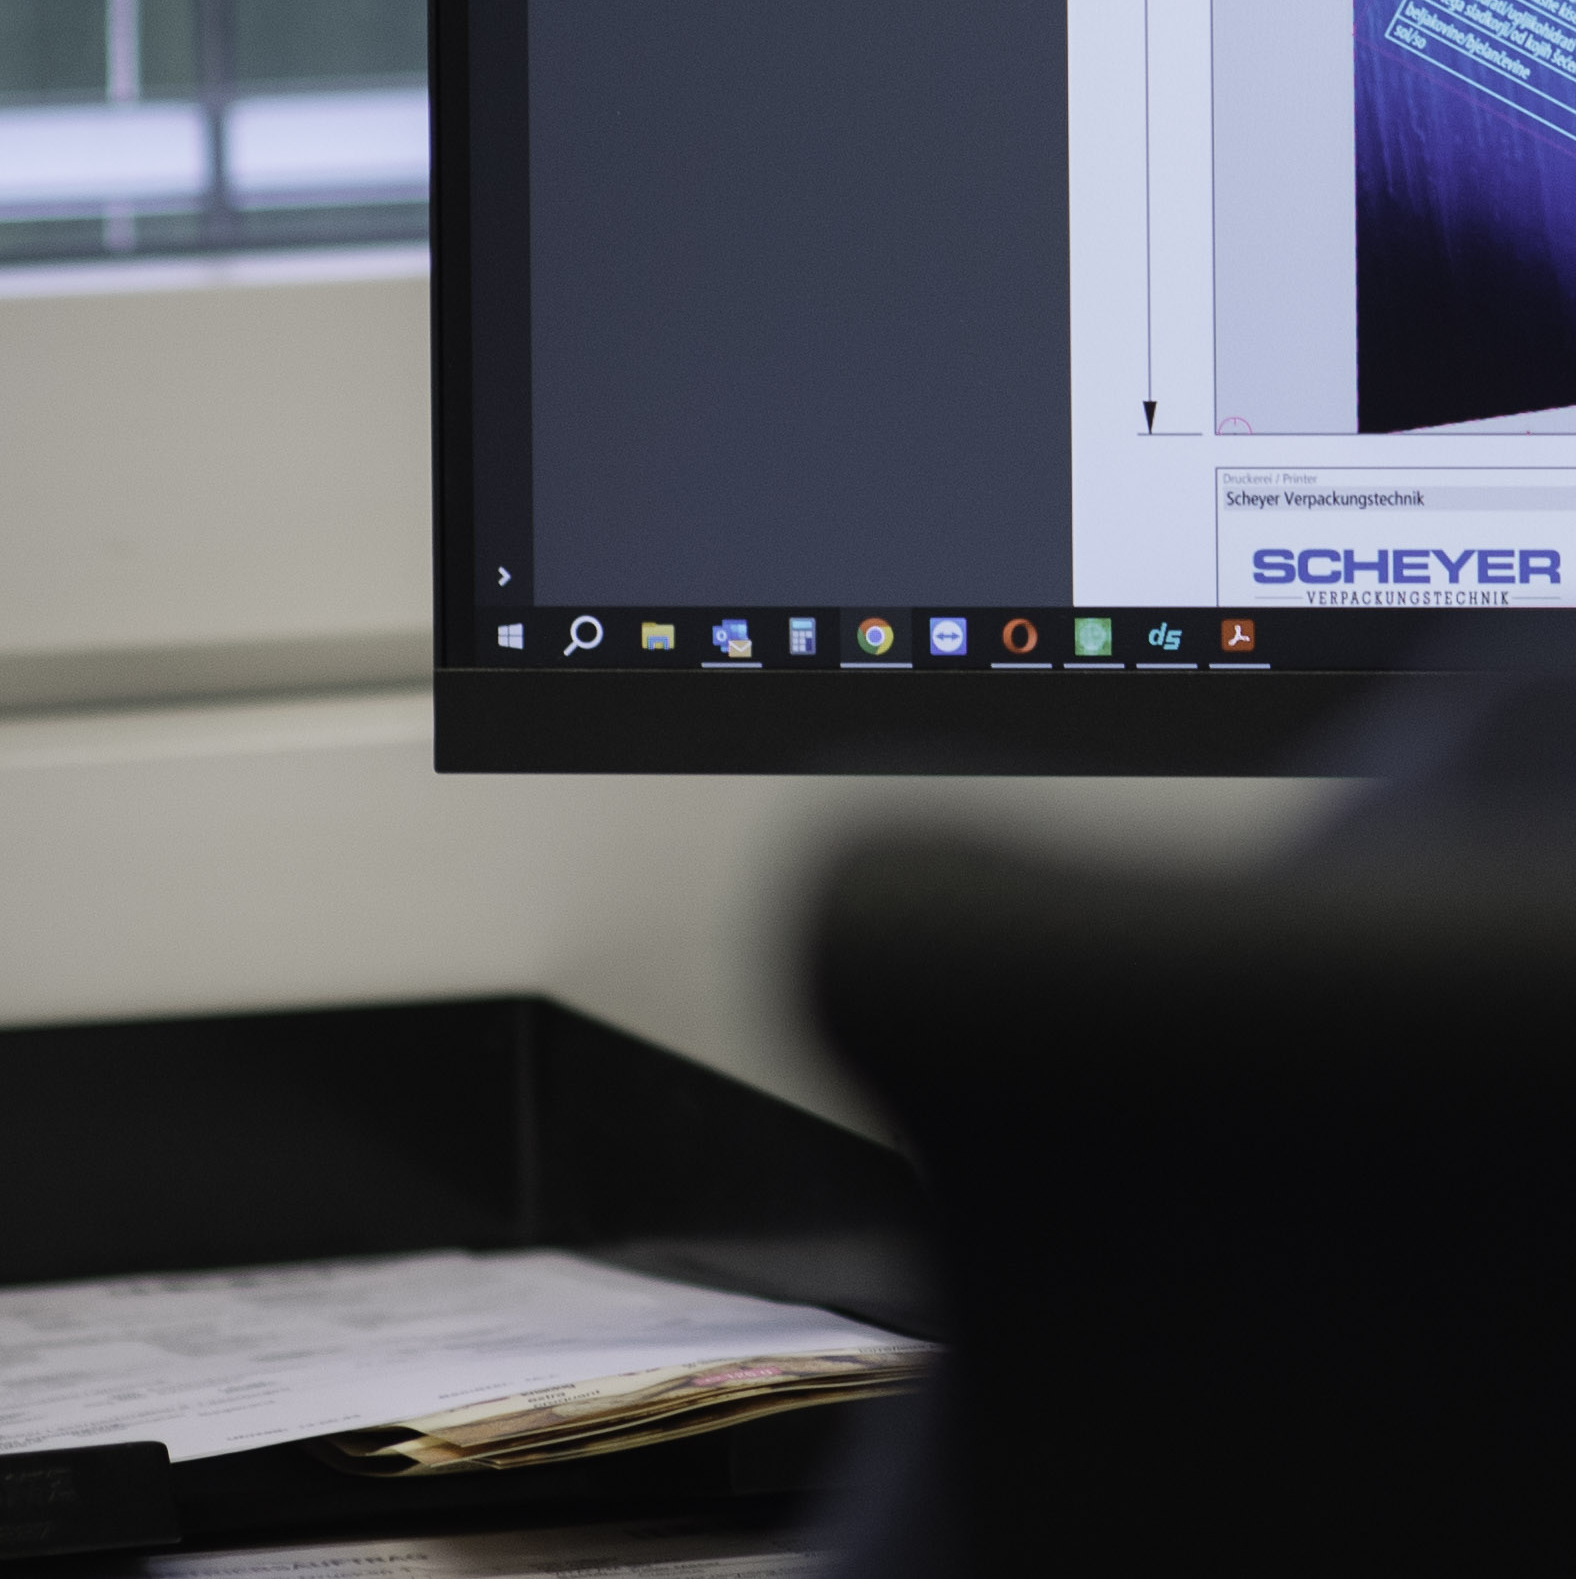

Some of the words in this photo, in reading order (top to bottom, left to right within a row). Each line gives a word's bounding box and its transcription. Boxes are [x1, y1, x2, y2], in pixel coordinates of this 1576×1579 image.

[1222, 472, 1272, 484] Druckerei
[1282, 472, 1316, 484] Printer
[1226, 490, 1279, 509] Scheyer
[1284, 490, 1424, 509] Verpackungstechnik
[1253, 548, 1561, 585] SCHEYER
[1307, 590, 1511, 606] VERPACKUNGSTECHNIK
